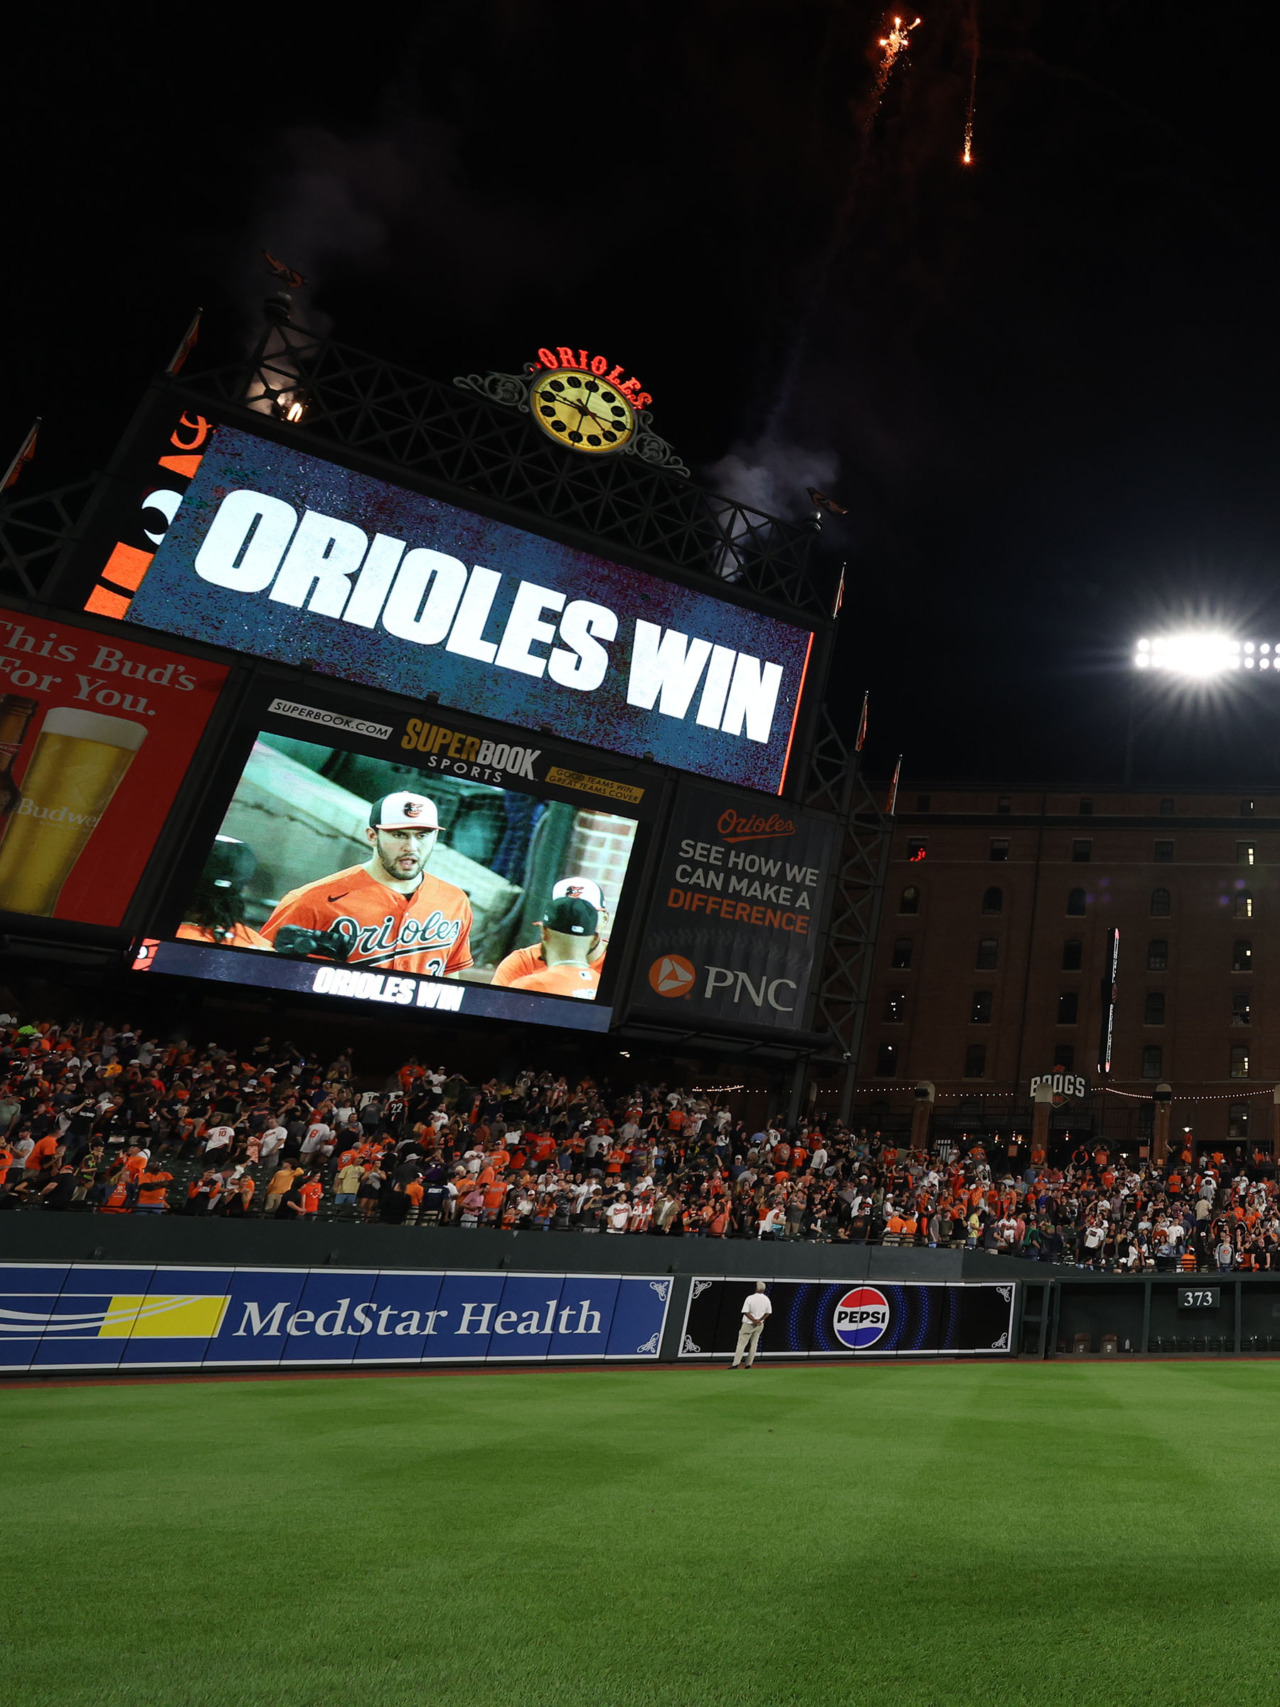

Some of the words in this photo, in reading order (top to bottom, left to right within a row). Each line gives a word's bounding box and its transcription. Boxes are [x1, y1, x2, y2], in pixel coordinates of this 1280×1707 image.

[538, 347, 652, 410] ORIOLES
[194, 489, 619, 691] ORIOLES
[626, 618, 784, 743] WIN
[0, 620, 78, 662] his
[89, 645, 197, 691] Bud's
[73, 674, 156, 715] You.
[274, 702, 389, 738] SUPERBOOK.COM
[401, 718, 542, 781] SUPERBOOK
[427, 755, 503, 783] SPORTS
[549, 775, 578, 787] GREAT
[580, 782, 606, 795] TEAMS
[609, 790, 638, 802] COVER
[556, 769, 584, 781] GOOD
[587, 777, 614, 789] TEAMS
[616, 783, 633, 793] WIN
[717, 809, 795, 841] Orioles
[679, 839, 725, 866] SEE
[728, 850, 782, 877] HOW
[785, 862, 819, 887] WE
[675, 864, 723, 890] CAN
[728, 875, 793, 906] MAKE
[795, 891, 811, 910] A
[667, 888, 810, 934] DIFFERENCE
[327, 910, 462, 964] Orioles
[312, 967, 416, 1004] ORIOLES
[416, 981, 465, 1012] WIN
[704, 965, 797, 1011] PNC
[233, 1298, 447, 1337] MedStar
[453, 1299, 601, 1336] Health
[837, 1311, 886, 1324] PEPSI
[1184, 1292, 1213, 1306] 373
